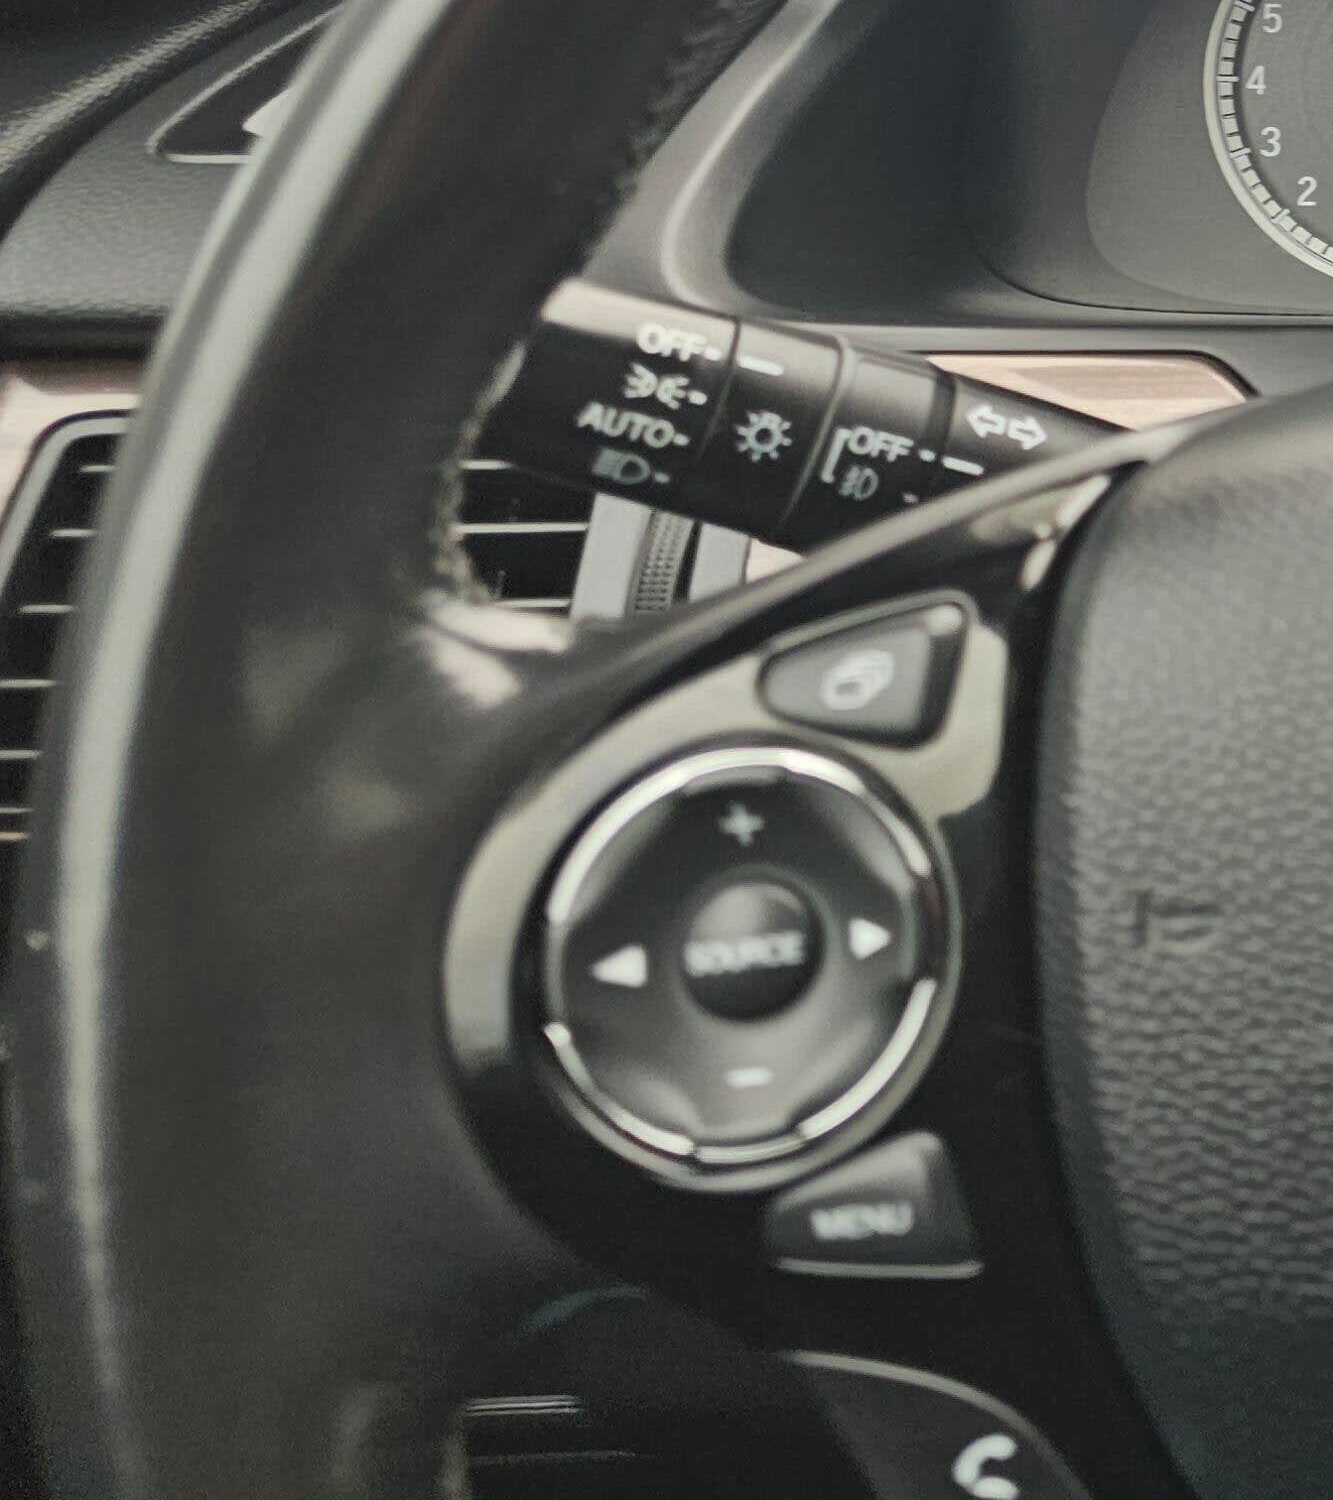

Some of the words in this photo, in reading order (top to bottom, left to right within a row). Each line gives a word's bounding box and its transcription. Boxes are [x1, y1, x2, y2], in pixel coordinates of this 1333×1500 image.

[1262, 4, 1283, 33] 5
[1246, 65, 1267, 95] 4
[1261, 125, 1281, 157] 3
[1297, 176, 1317, 207] 2
[636, 323, 706, 360] OFF
[578, 403, 675, 449] AUTO
[847, 426, 915, 463] OFF
